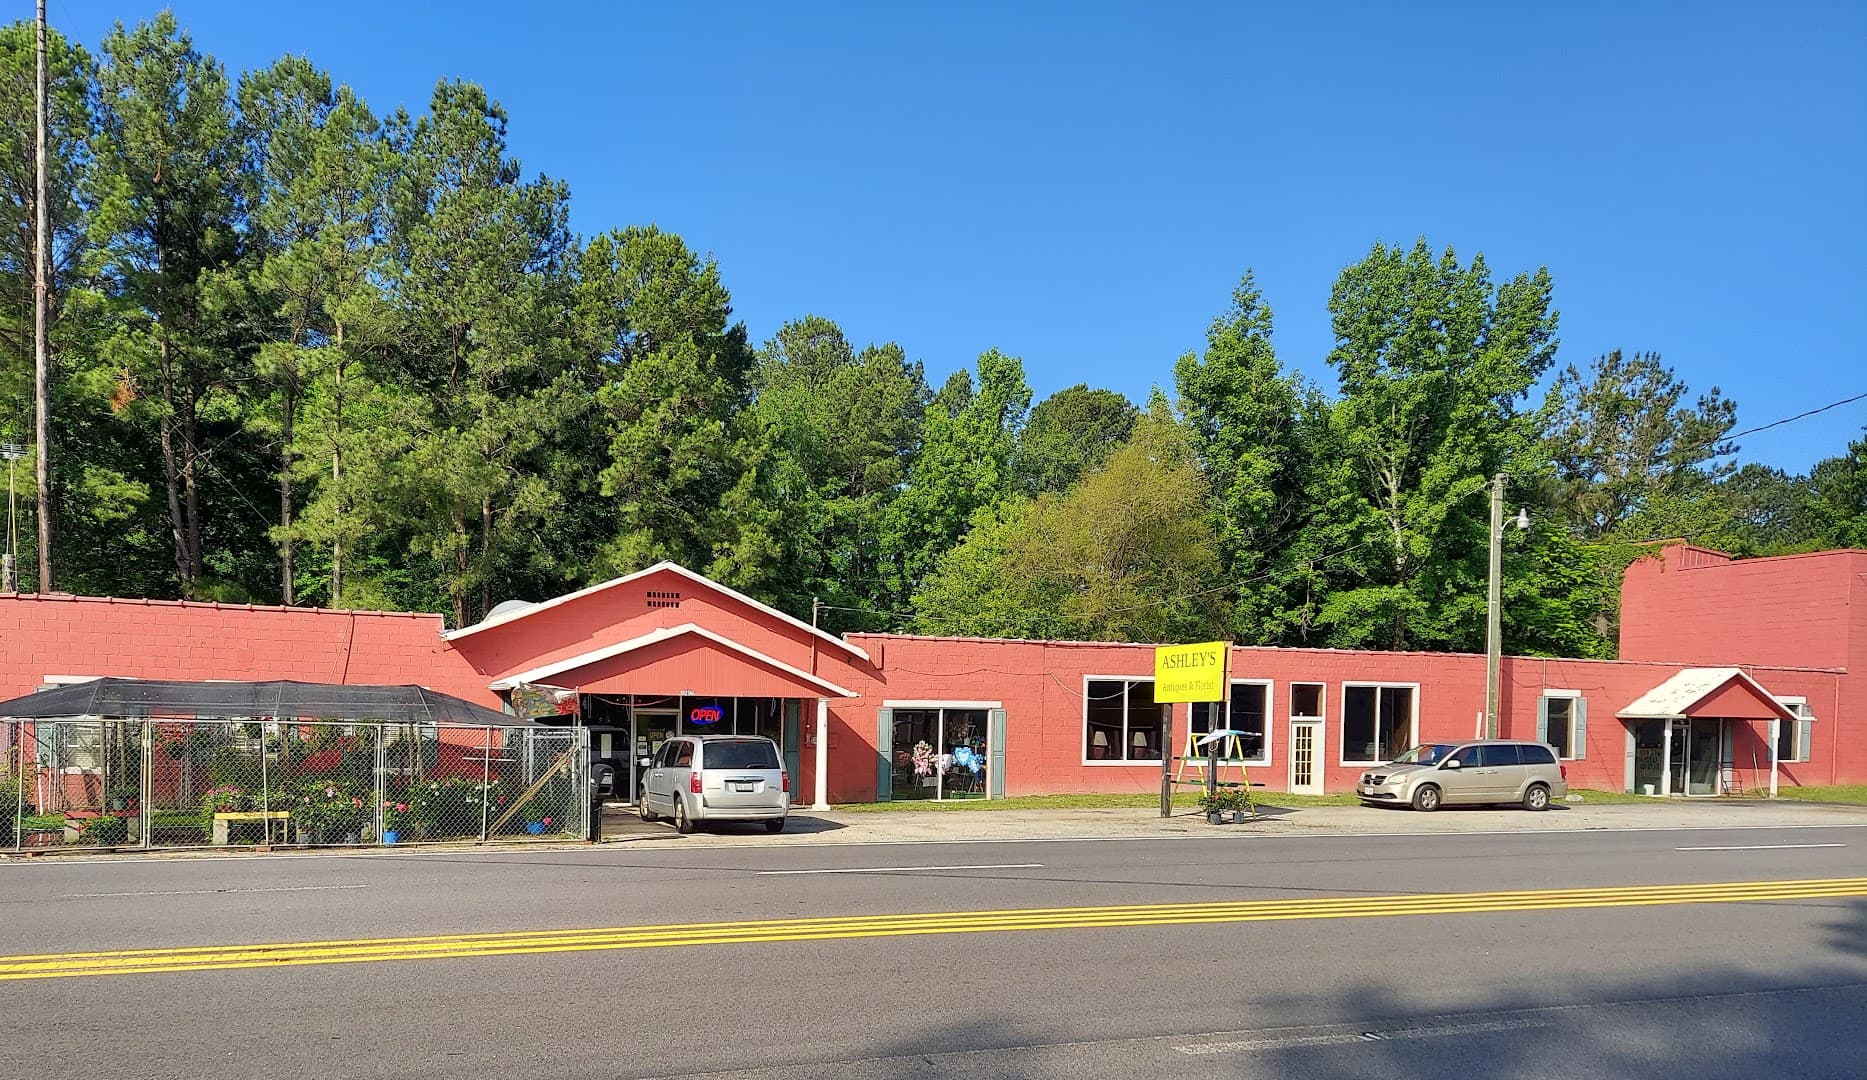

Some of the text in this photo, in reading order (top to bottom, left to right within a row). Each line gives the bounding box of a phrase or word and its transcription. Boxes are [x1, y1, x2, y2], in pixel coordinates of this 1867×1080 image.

[1162, 651, 1216, 669] ASHLEY'S
[1162, 683, 1187, 693] Antiques
[1195, 680, 1214, 690] Florist
[691, 709, 720, 722] OPEN
